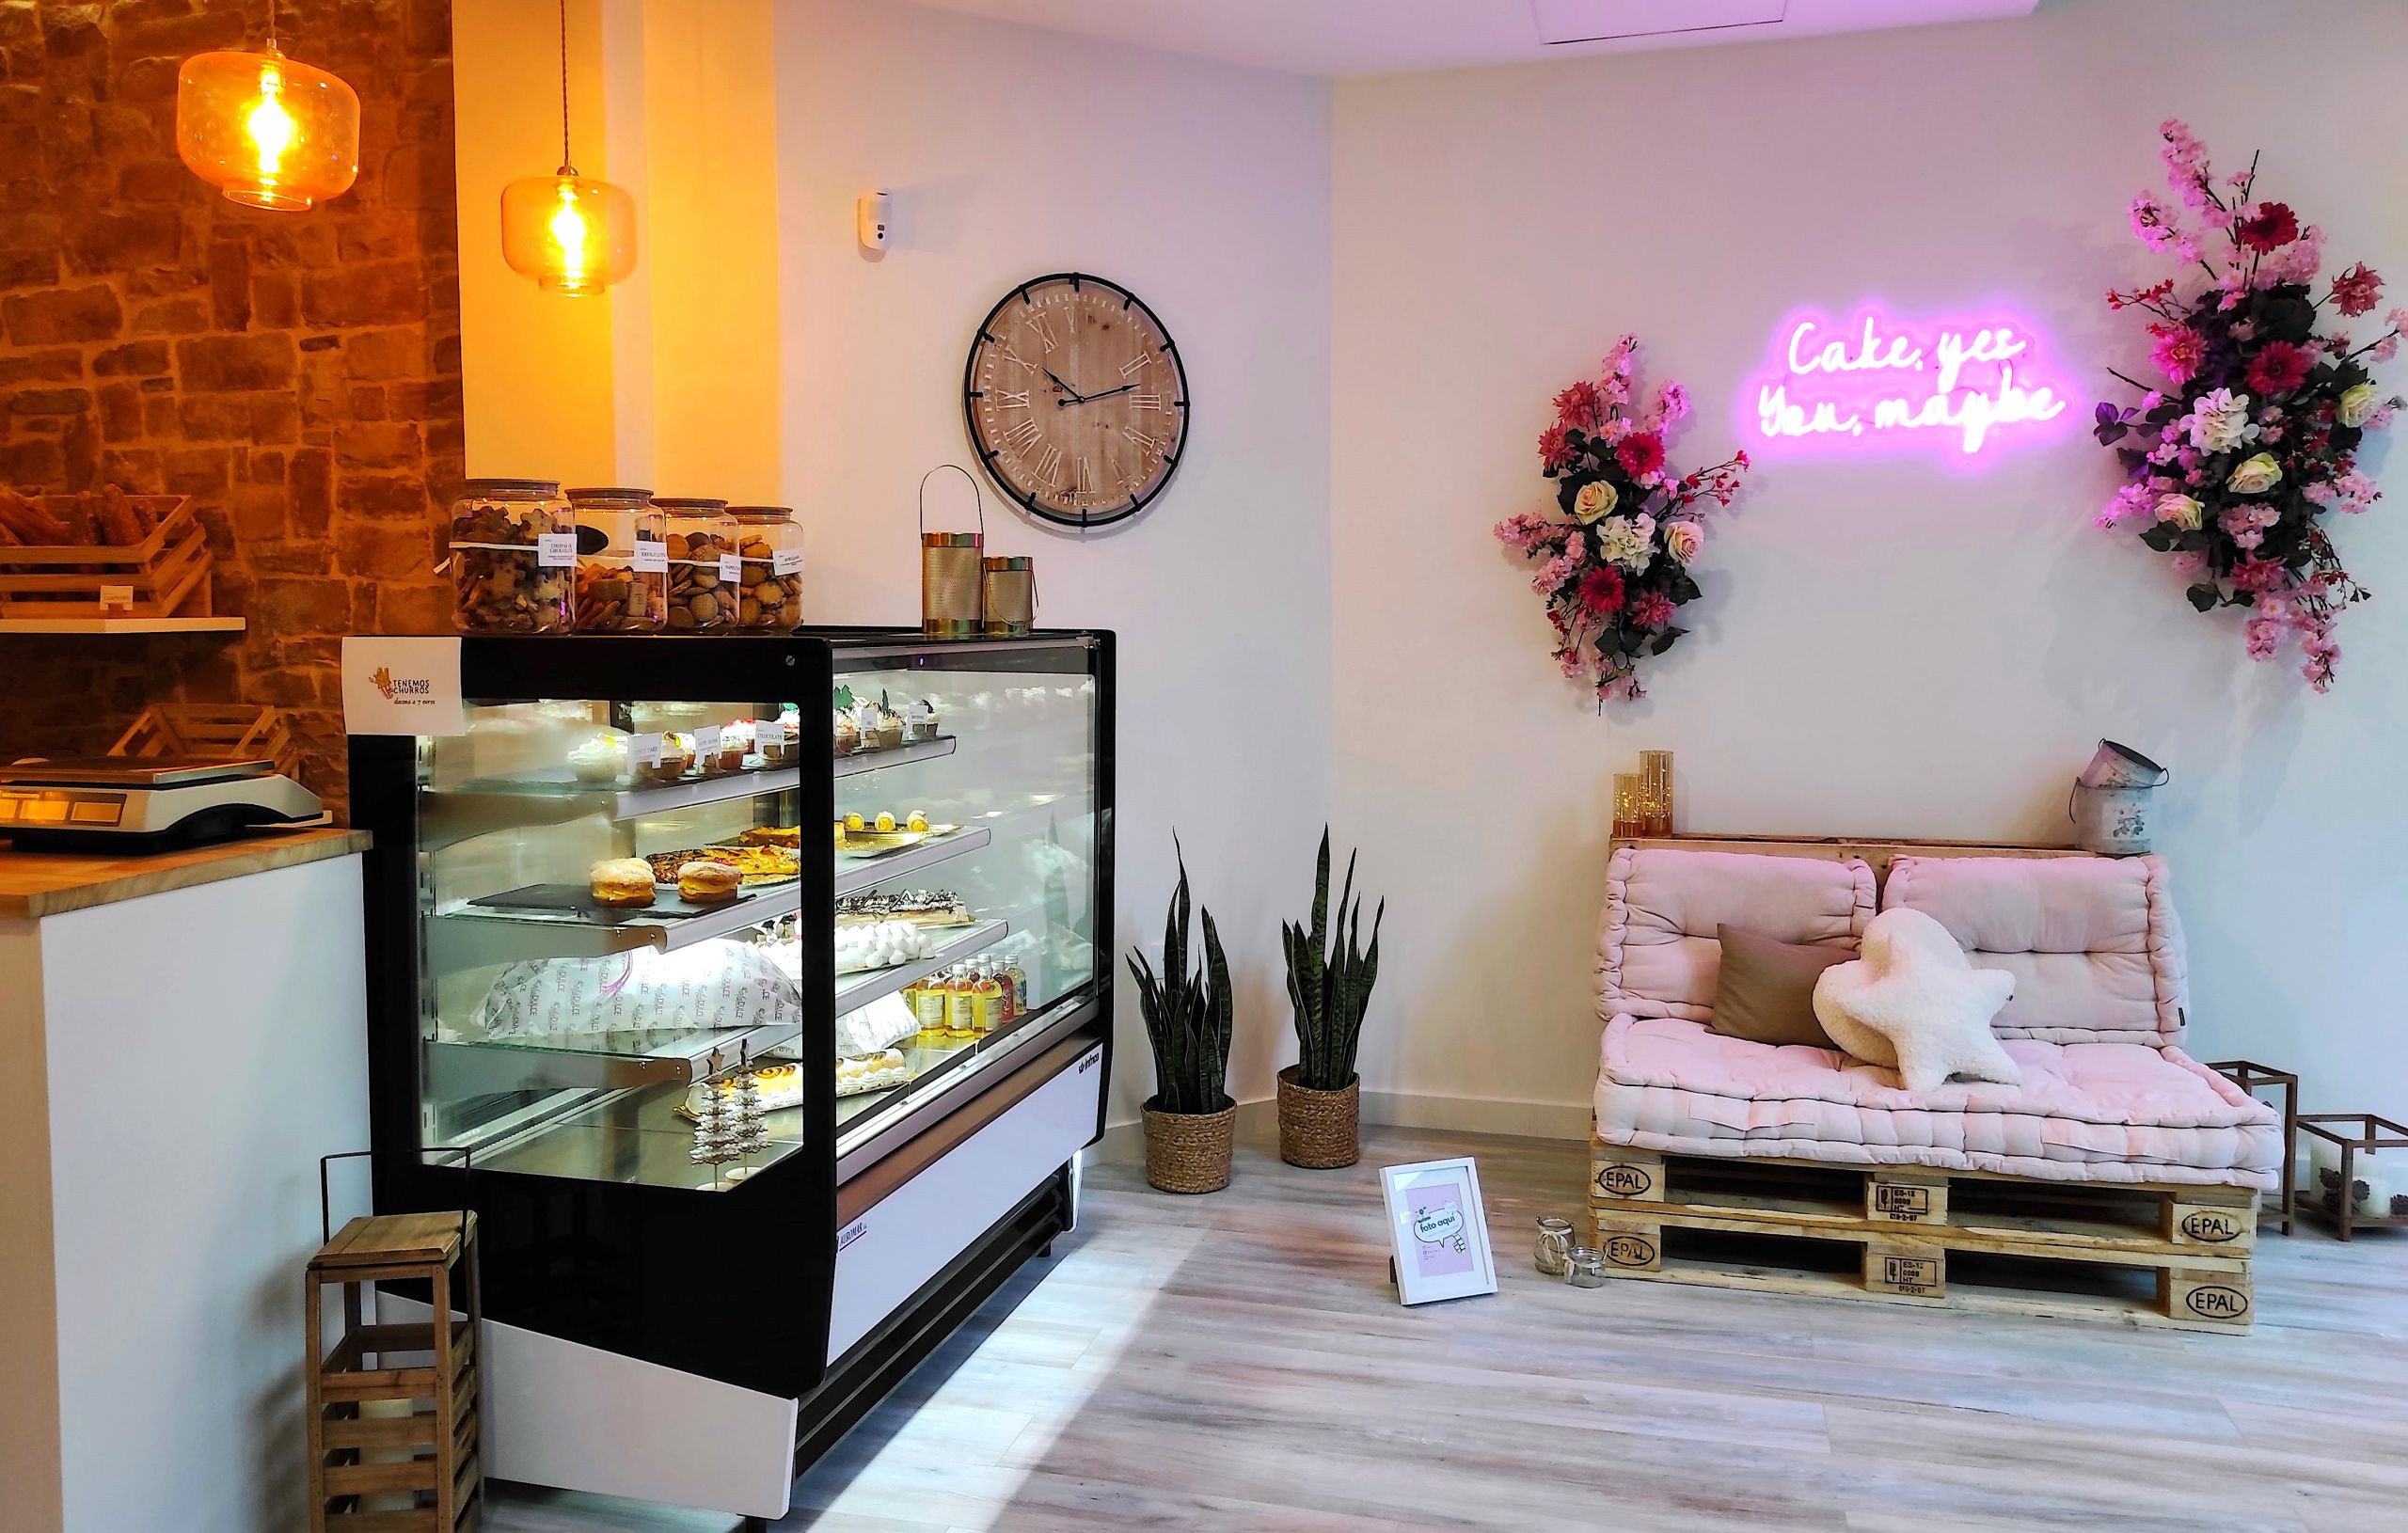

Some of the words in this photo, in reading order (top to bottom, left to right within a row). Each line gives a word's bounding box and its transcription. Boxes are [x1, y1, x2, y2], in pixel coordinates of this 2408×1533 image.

[1937, 328, 2026, 393] yes
[1875, 366, 2067, 453] maybe
[393, 679, 430, 687] TENEMOS
[1606, 1171, 1643, 1190] EPAL
[1419, 1223, 1436, 1233] foto
[1437, 1212, 1456, 1226] aquí
[2191, 1217, 2234, 1235] EPAL
[1610, 1241, 1647, 1261] EPAL
[2195, 1292, 2239, 1313] EPAL
